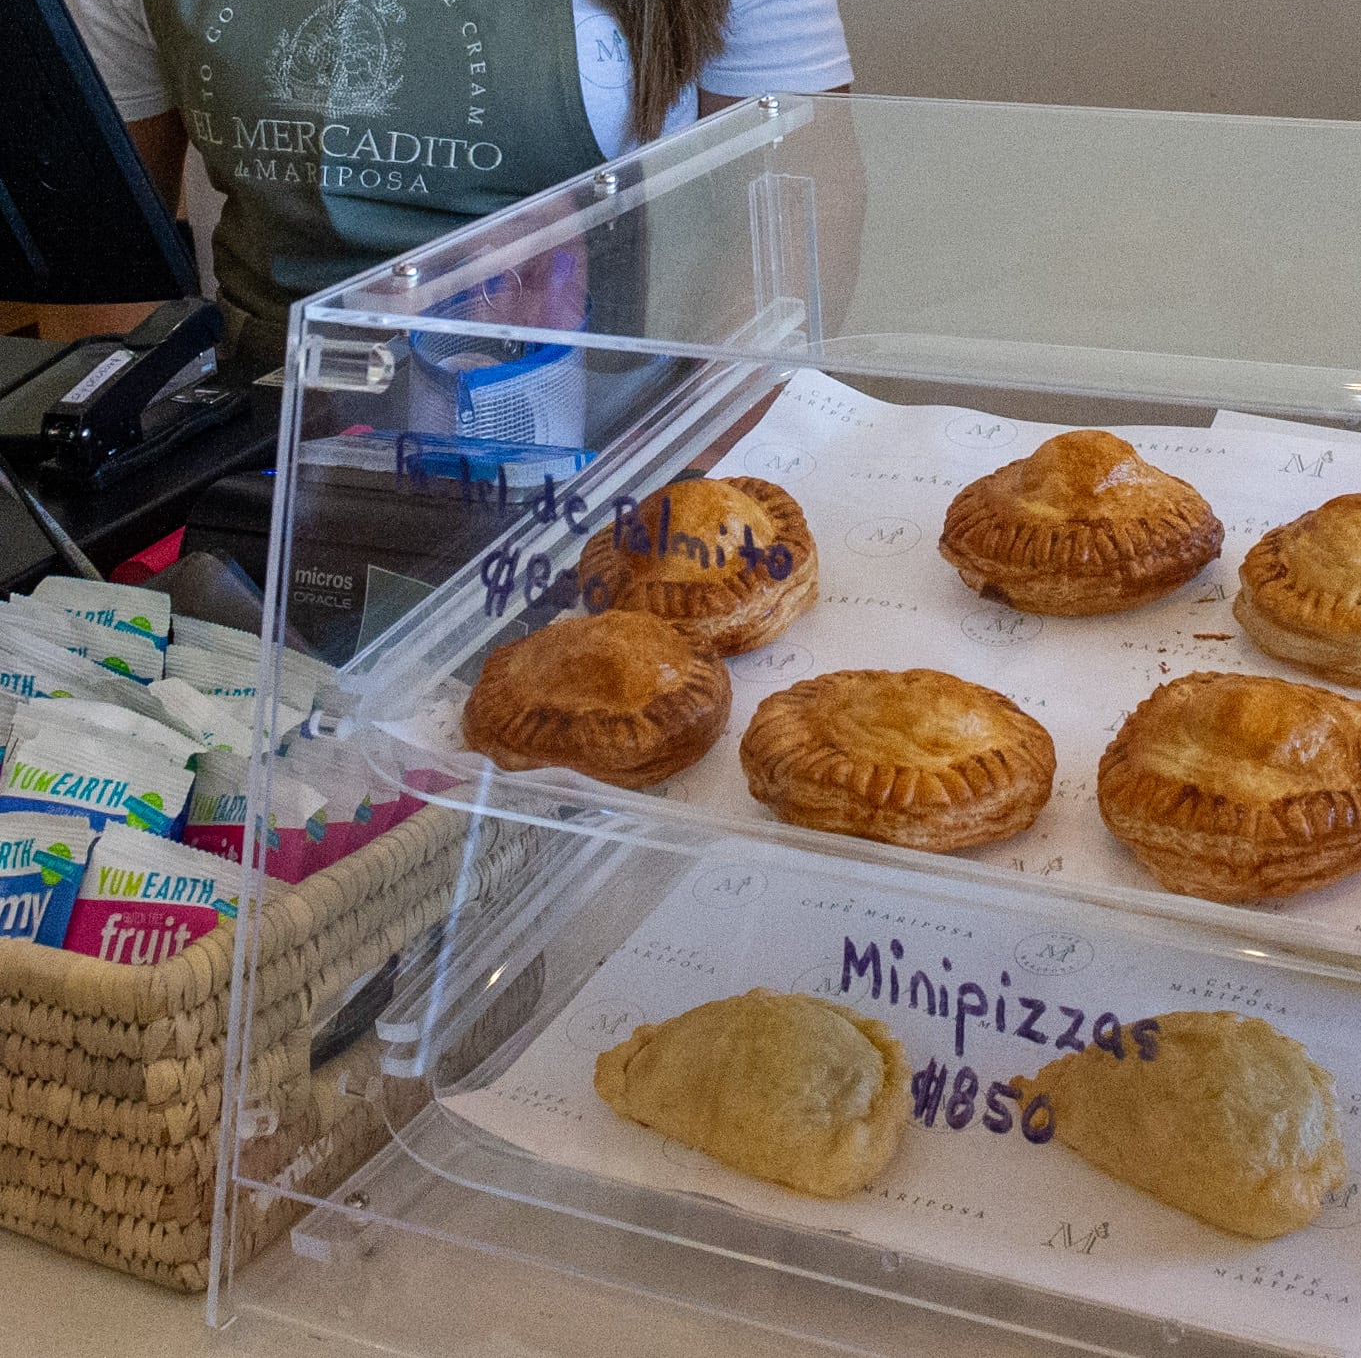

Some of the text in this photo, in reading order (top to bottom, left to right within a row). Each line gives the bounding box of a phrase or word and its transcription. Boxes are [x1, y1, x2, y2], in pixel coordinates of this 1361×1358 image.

[199, 6, 235, 101] TO GO
[460, 20, 488, 127] CREAM
[193, 109, 504, 172] EL MERCADITO
[233, 158, 430, 194] de MARIPOSA
[1136, 442, 1228, 456] ARIPOSA
[612, 494, 794, 582] Palmito
[294, 566, 354, 591] micros
[293, 591, 353, 610] ORACLE
[823, 594, 919, 613] ARIPOSA
[8, 760, 130, 809] YUMEARTH
[191, 793, 247, 823] YUMEART
[97, 865, 216, 905] YUMEARTH
[99, 911, 193, 966] fruit
[864, 908, 975, 940] MARIPOSA
[630, 945, 716, 975] ARIPOSA
[839, 934, 1163, 1063] Minipizzas
[1170, 982, 1288, 1016] MARIPOSA
